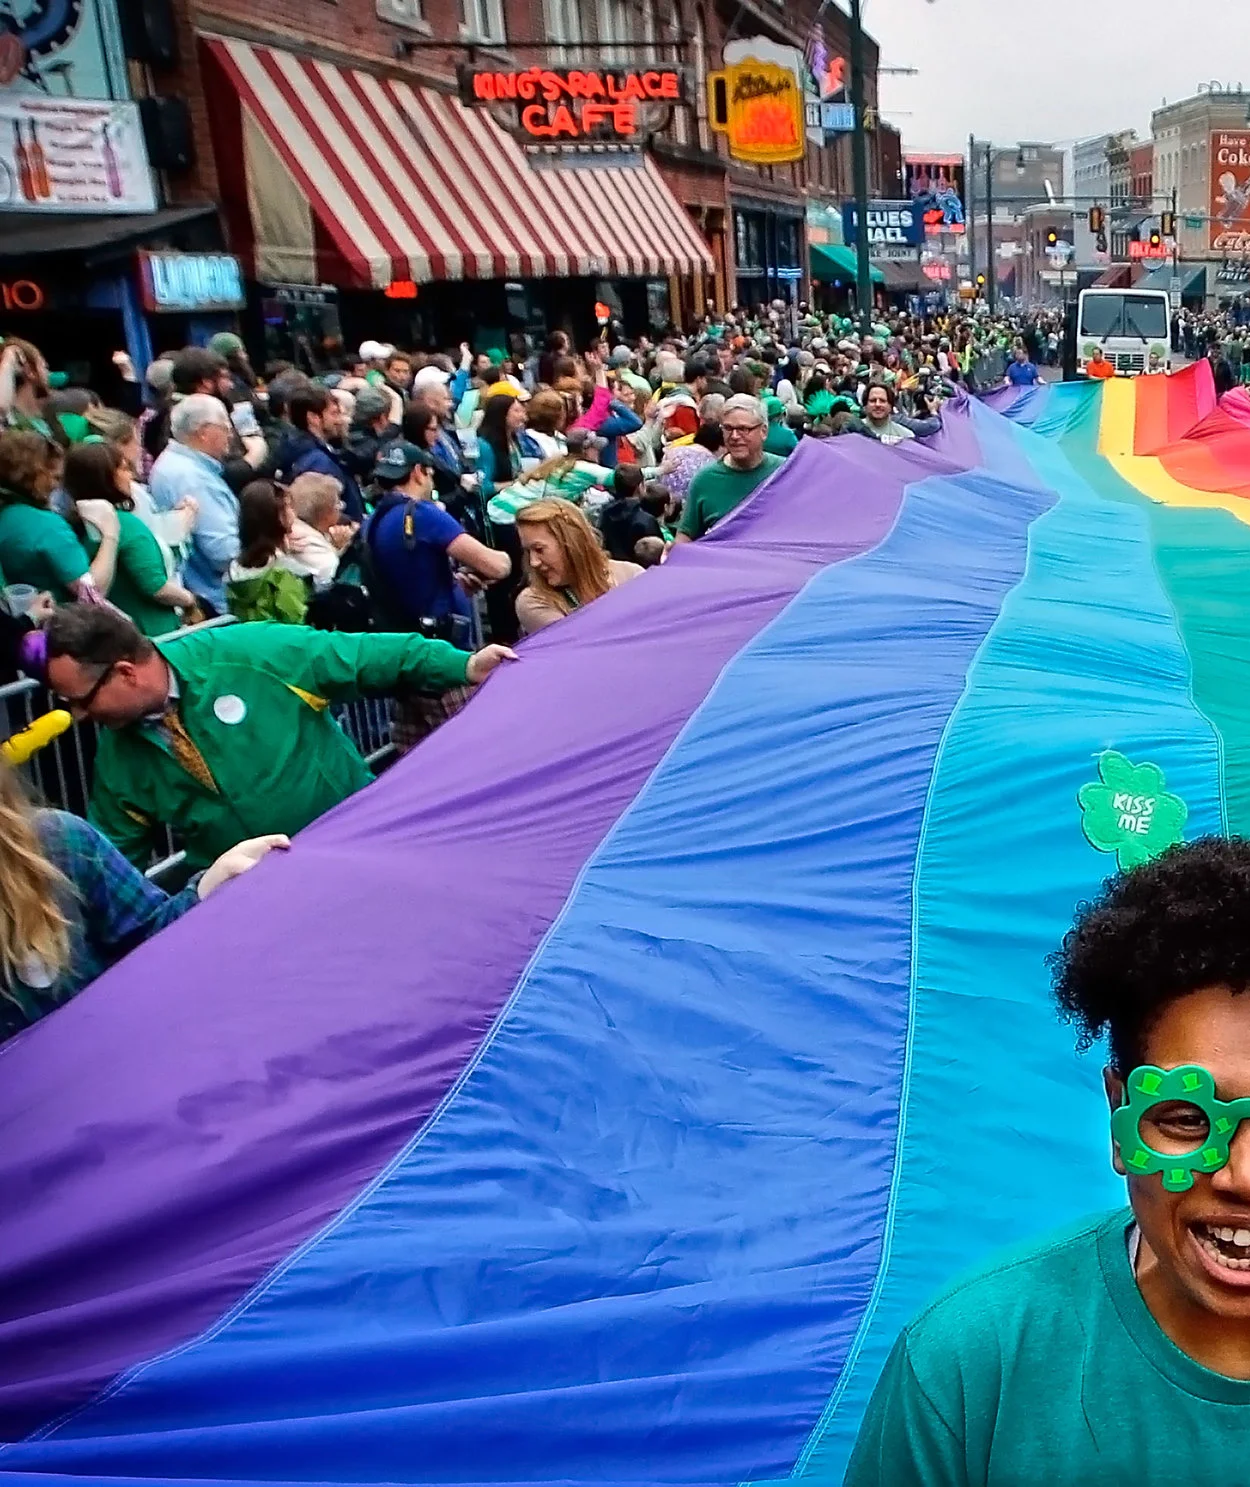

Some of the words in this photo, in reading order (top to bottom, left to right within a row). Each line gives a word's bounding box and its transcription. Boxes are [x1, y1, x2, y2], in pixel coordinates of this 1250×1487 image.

[473, 66, 562, 101] KING'S
[567, 71, 680, 99] PALACE
[1219, 134, 1246, 146] Have
[1112, 792, 1155, 816] KISS
[1117, 813, 1151, 834] ME
